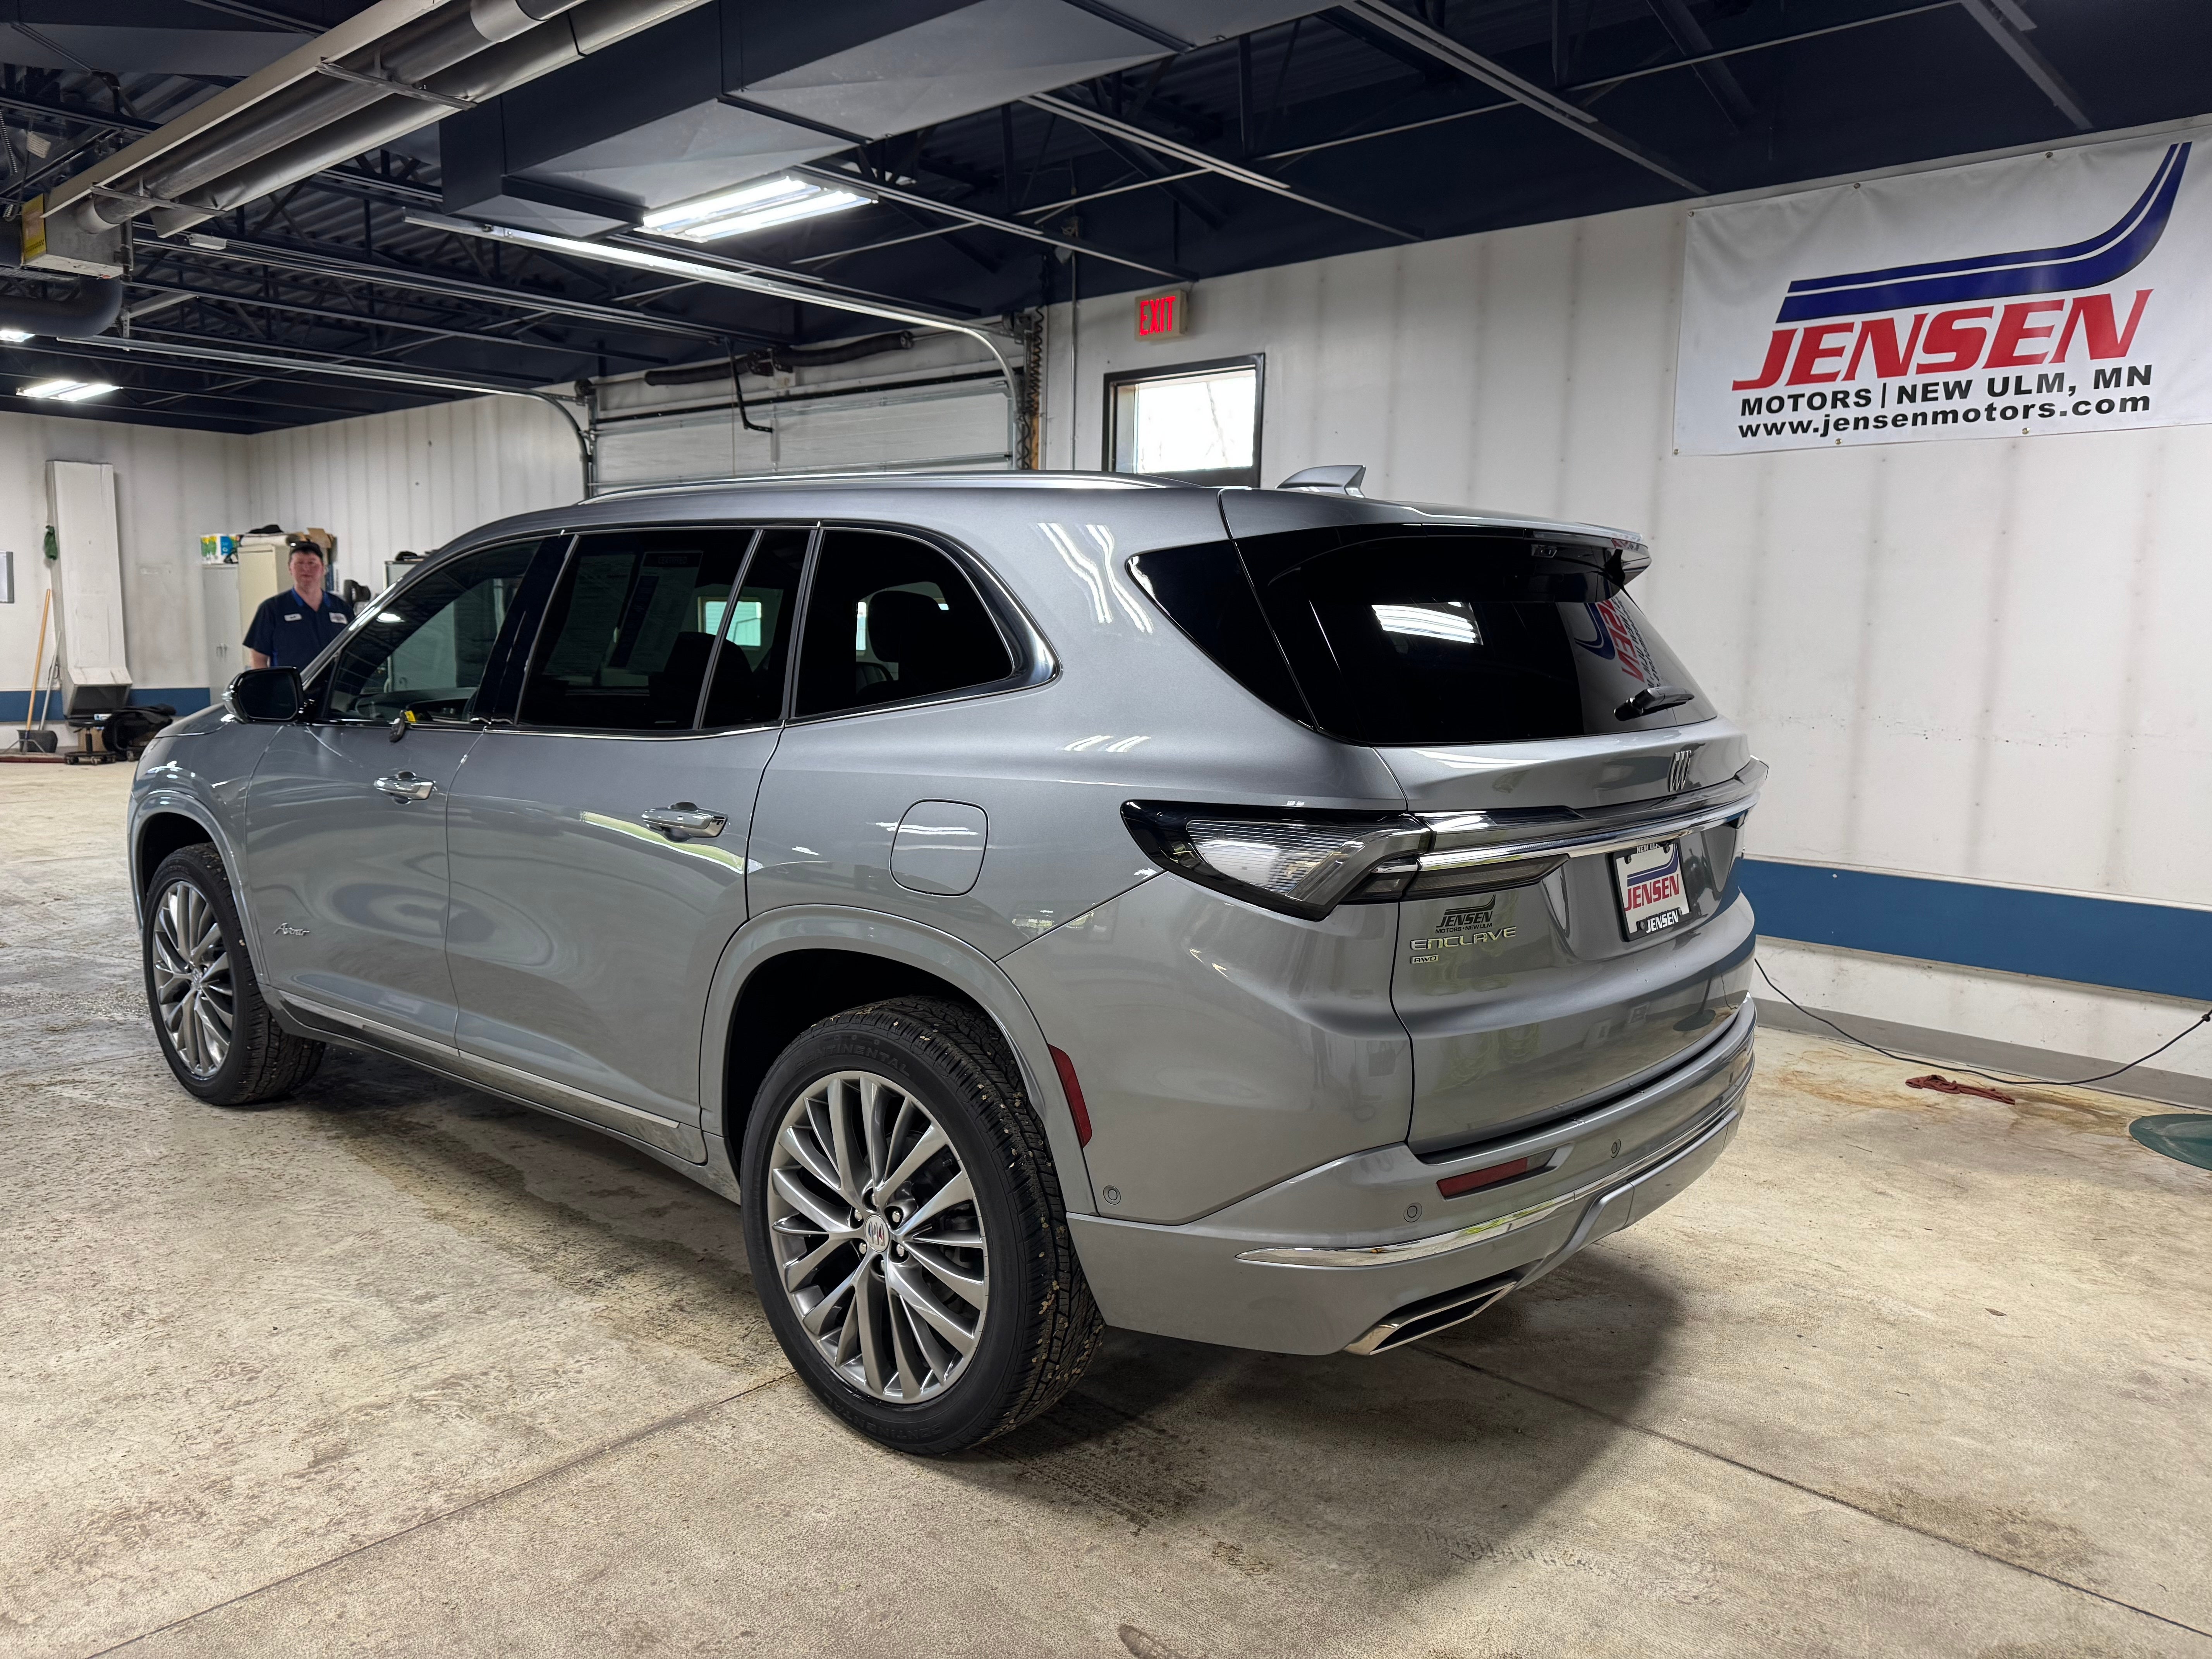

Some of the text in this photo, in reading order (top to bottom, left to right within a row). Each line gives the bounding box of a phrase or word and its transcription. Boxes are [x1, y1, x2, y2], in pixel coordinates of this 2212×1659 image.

[1140, 295, 1176, 336] EXIT
[1732, 289, 2153, 391] JENSEN
[1740, 364, 2152, 416] MOTORS NEW ULM, MN
[1738, 395, 2150, 438] www.jensenmotors.com
[1637, 844, 1649, 854] NEW
[1625, 874, 1680, 911] JENSEN
[1436, 910, 1493, 928] JENSEN
[1646, 910, 1679, 933] JENSEN
[1410, 926, 1516, 951] ENCLAVE
